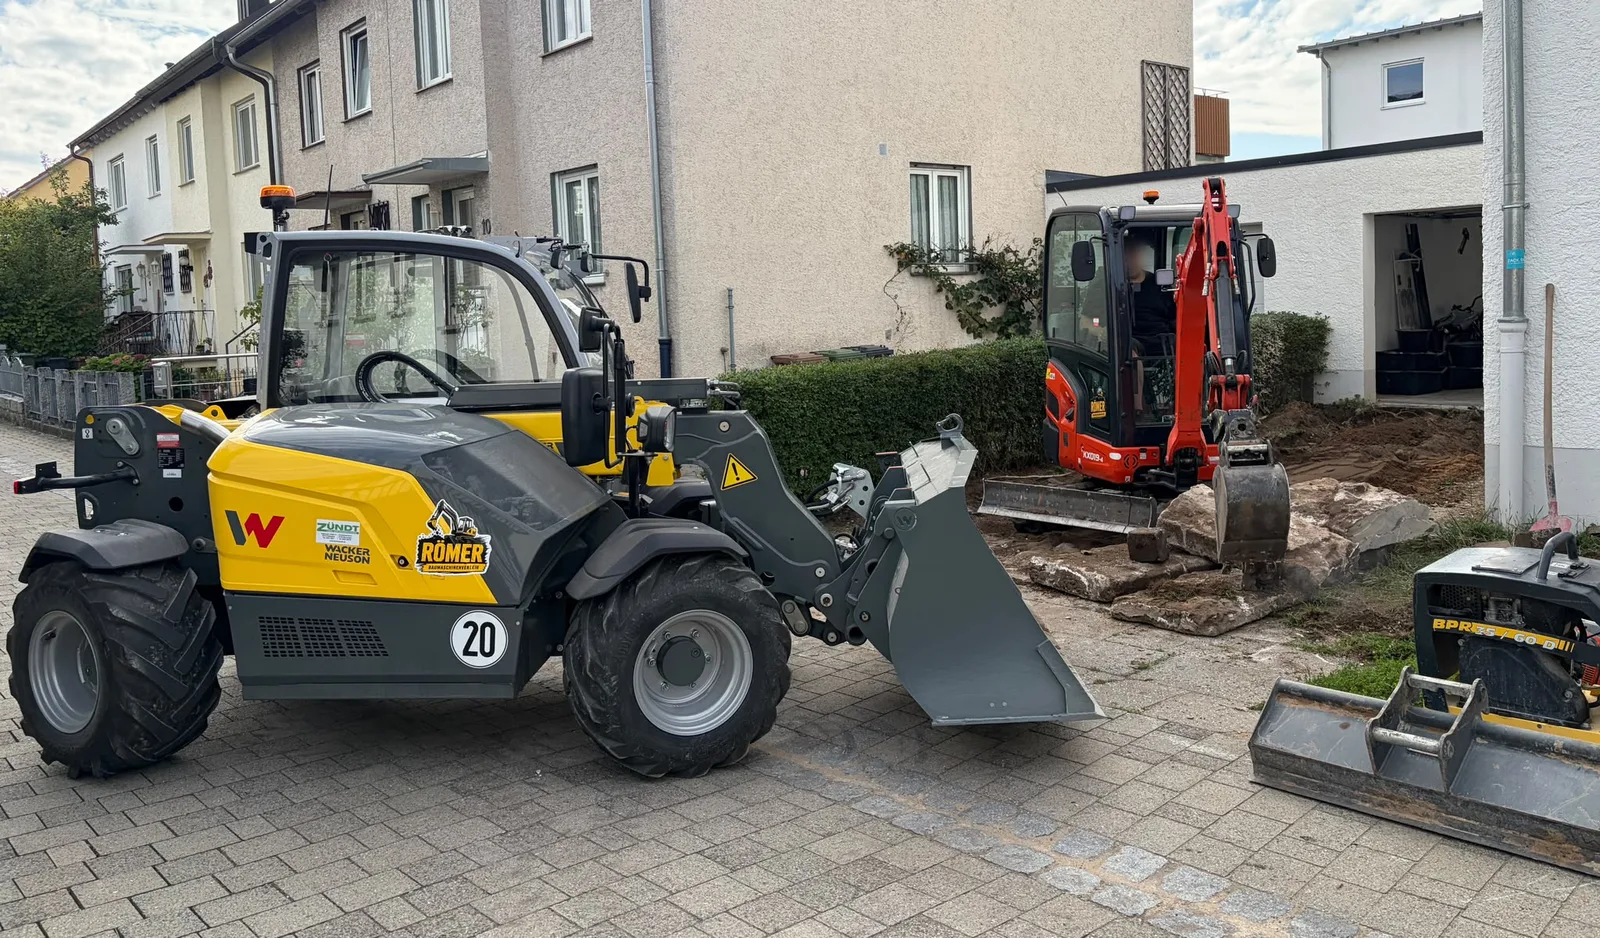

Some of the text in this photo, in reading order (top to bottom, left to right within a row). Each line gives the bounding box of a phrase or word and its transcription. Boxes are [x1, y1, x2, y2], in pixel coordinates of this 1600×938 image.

[481, 218, 491, 235] 10
[317, 522, 359, 532] ZÜNDT
[325, 544, 370, 556] WACKER
[325, 552, 370, 564] NEUSON
[421, 540, 484, 562] RÖMER
[463, 621, 496, 657] 20
[1433, 619, 1473, 632] BPR
[1514, 634, 1536, 645] 60
